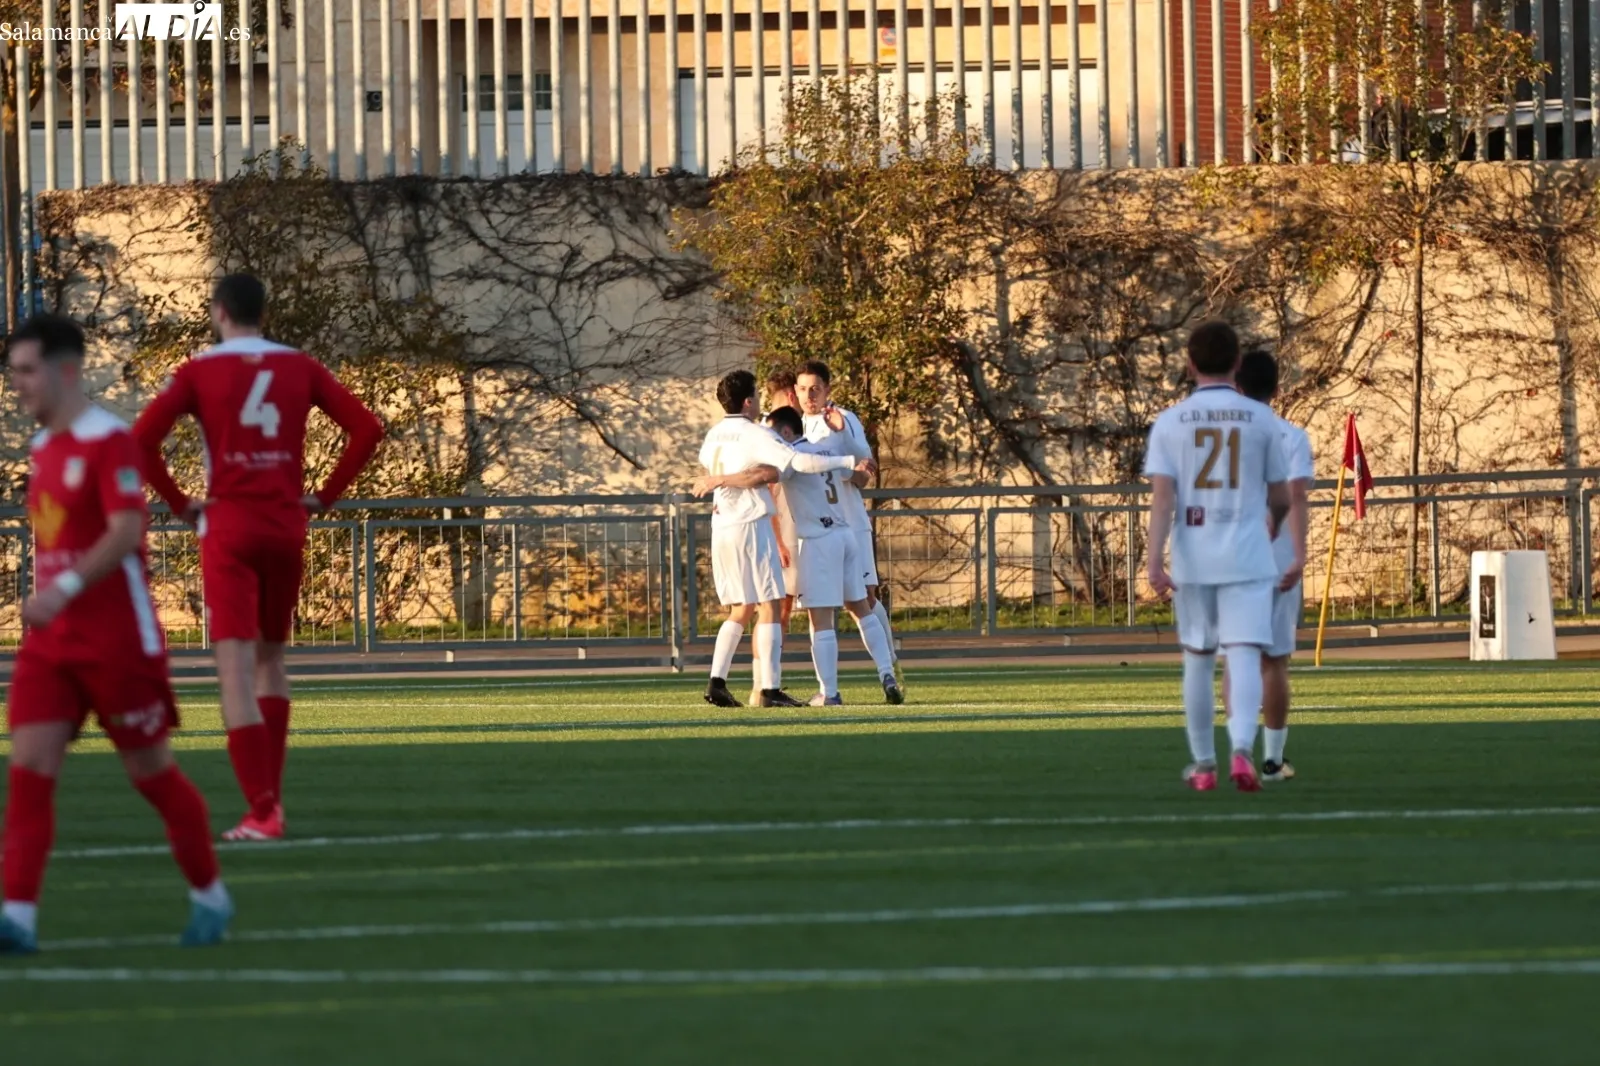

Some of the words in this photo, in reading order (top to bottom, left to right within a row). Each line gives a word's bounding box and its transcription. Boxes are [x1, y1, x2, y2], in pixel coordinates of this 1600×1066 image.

[240, 369, 280, 438] 4
[1207, 409, 1254, 423] RIBERT
[1194, 427, 1241, 489] 21
[821, 470, 839, 504] 3
